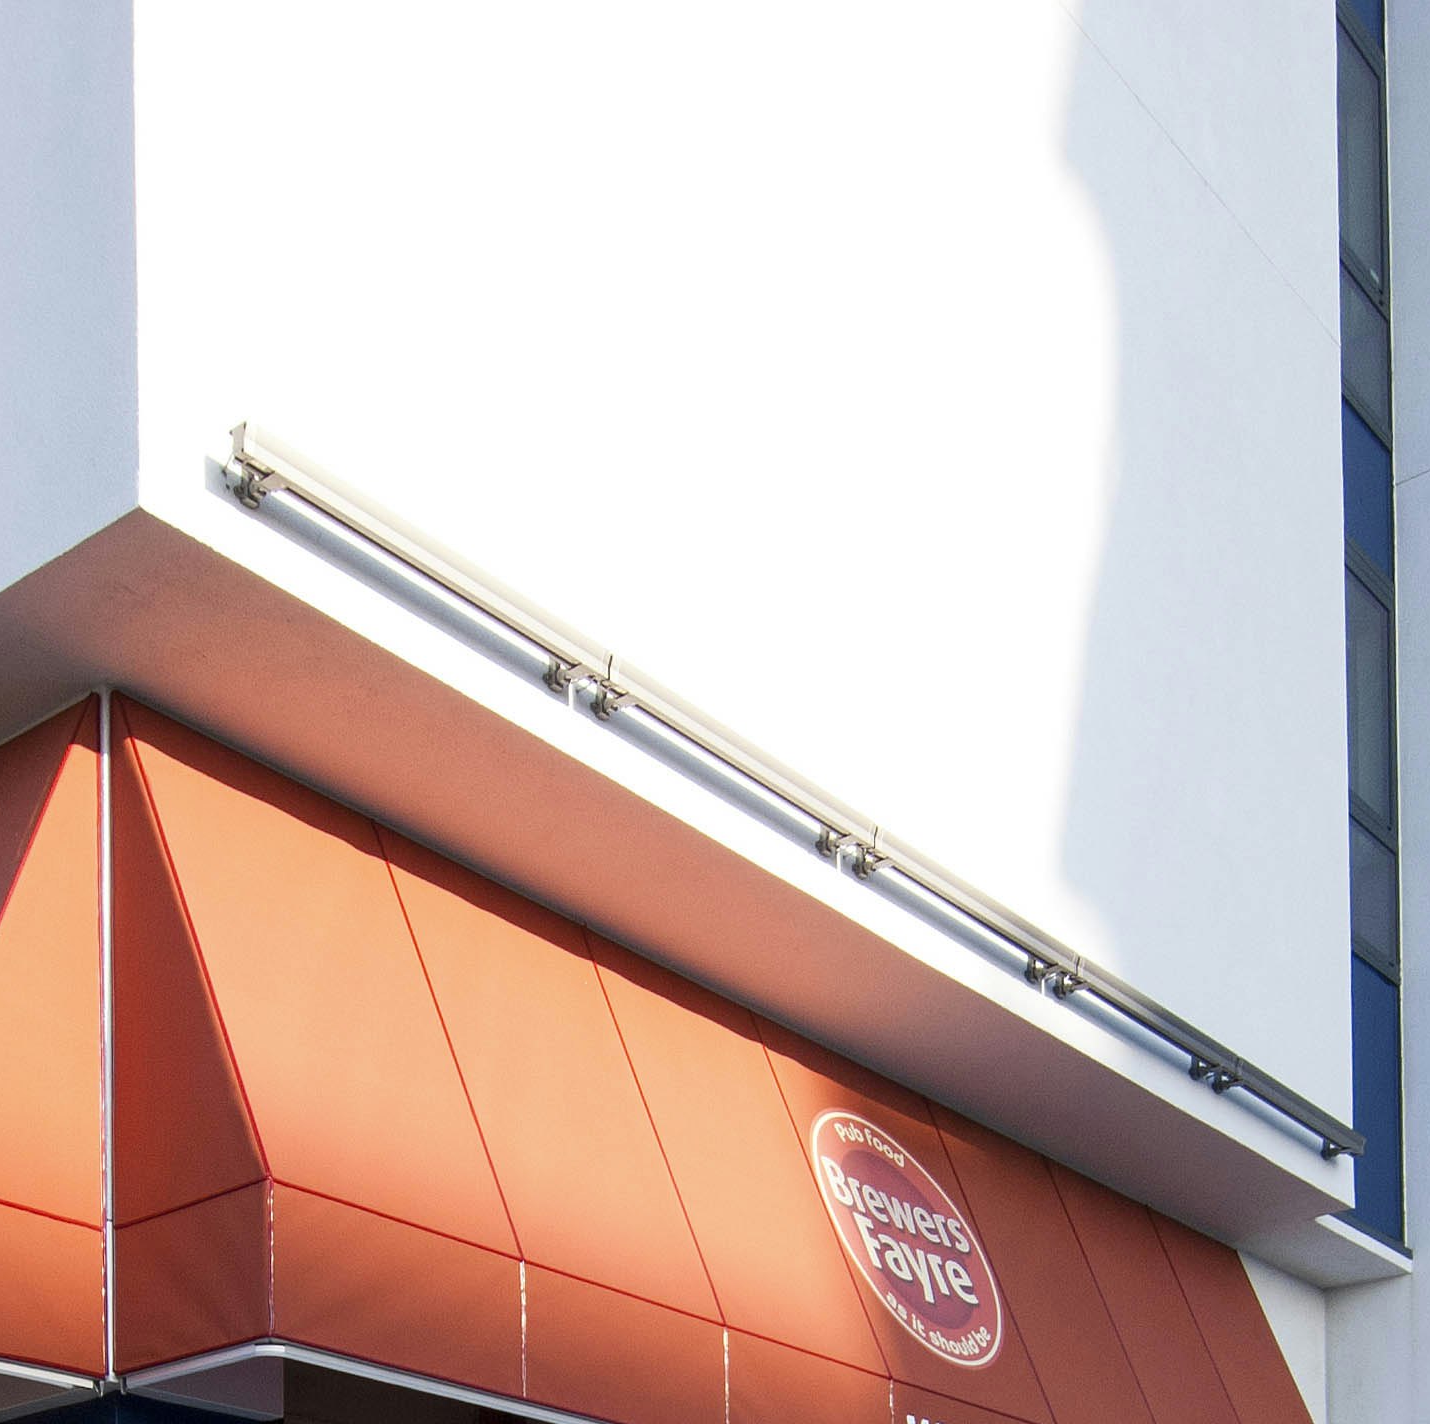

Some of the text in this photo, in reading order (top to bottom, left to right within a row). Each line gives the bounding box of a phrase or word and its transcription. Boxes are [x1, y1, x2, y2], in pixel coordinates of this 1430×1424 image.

[863, 1127, 905, 1168] food
[820, 1155, 971, 1254] Brewers
[852, 1212, 979, 1305] Fayre
[911, 1313, 926, 1338] it
[929, 1330, 980, 1356] should
[972, 1326, 991, 1347] be
